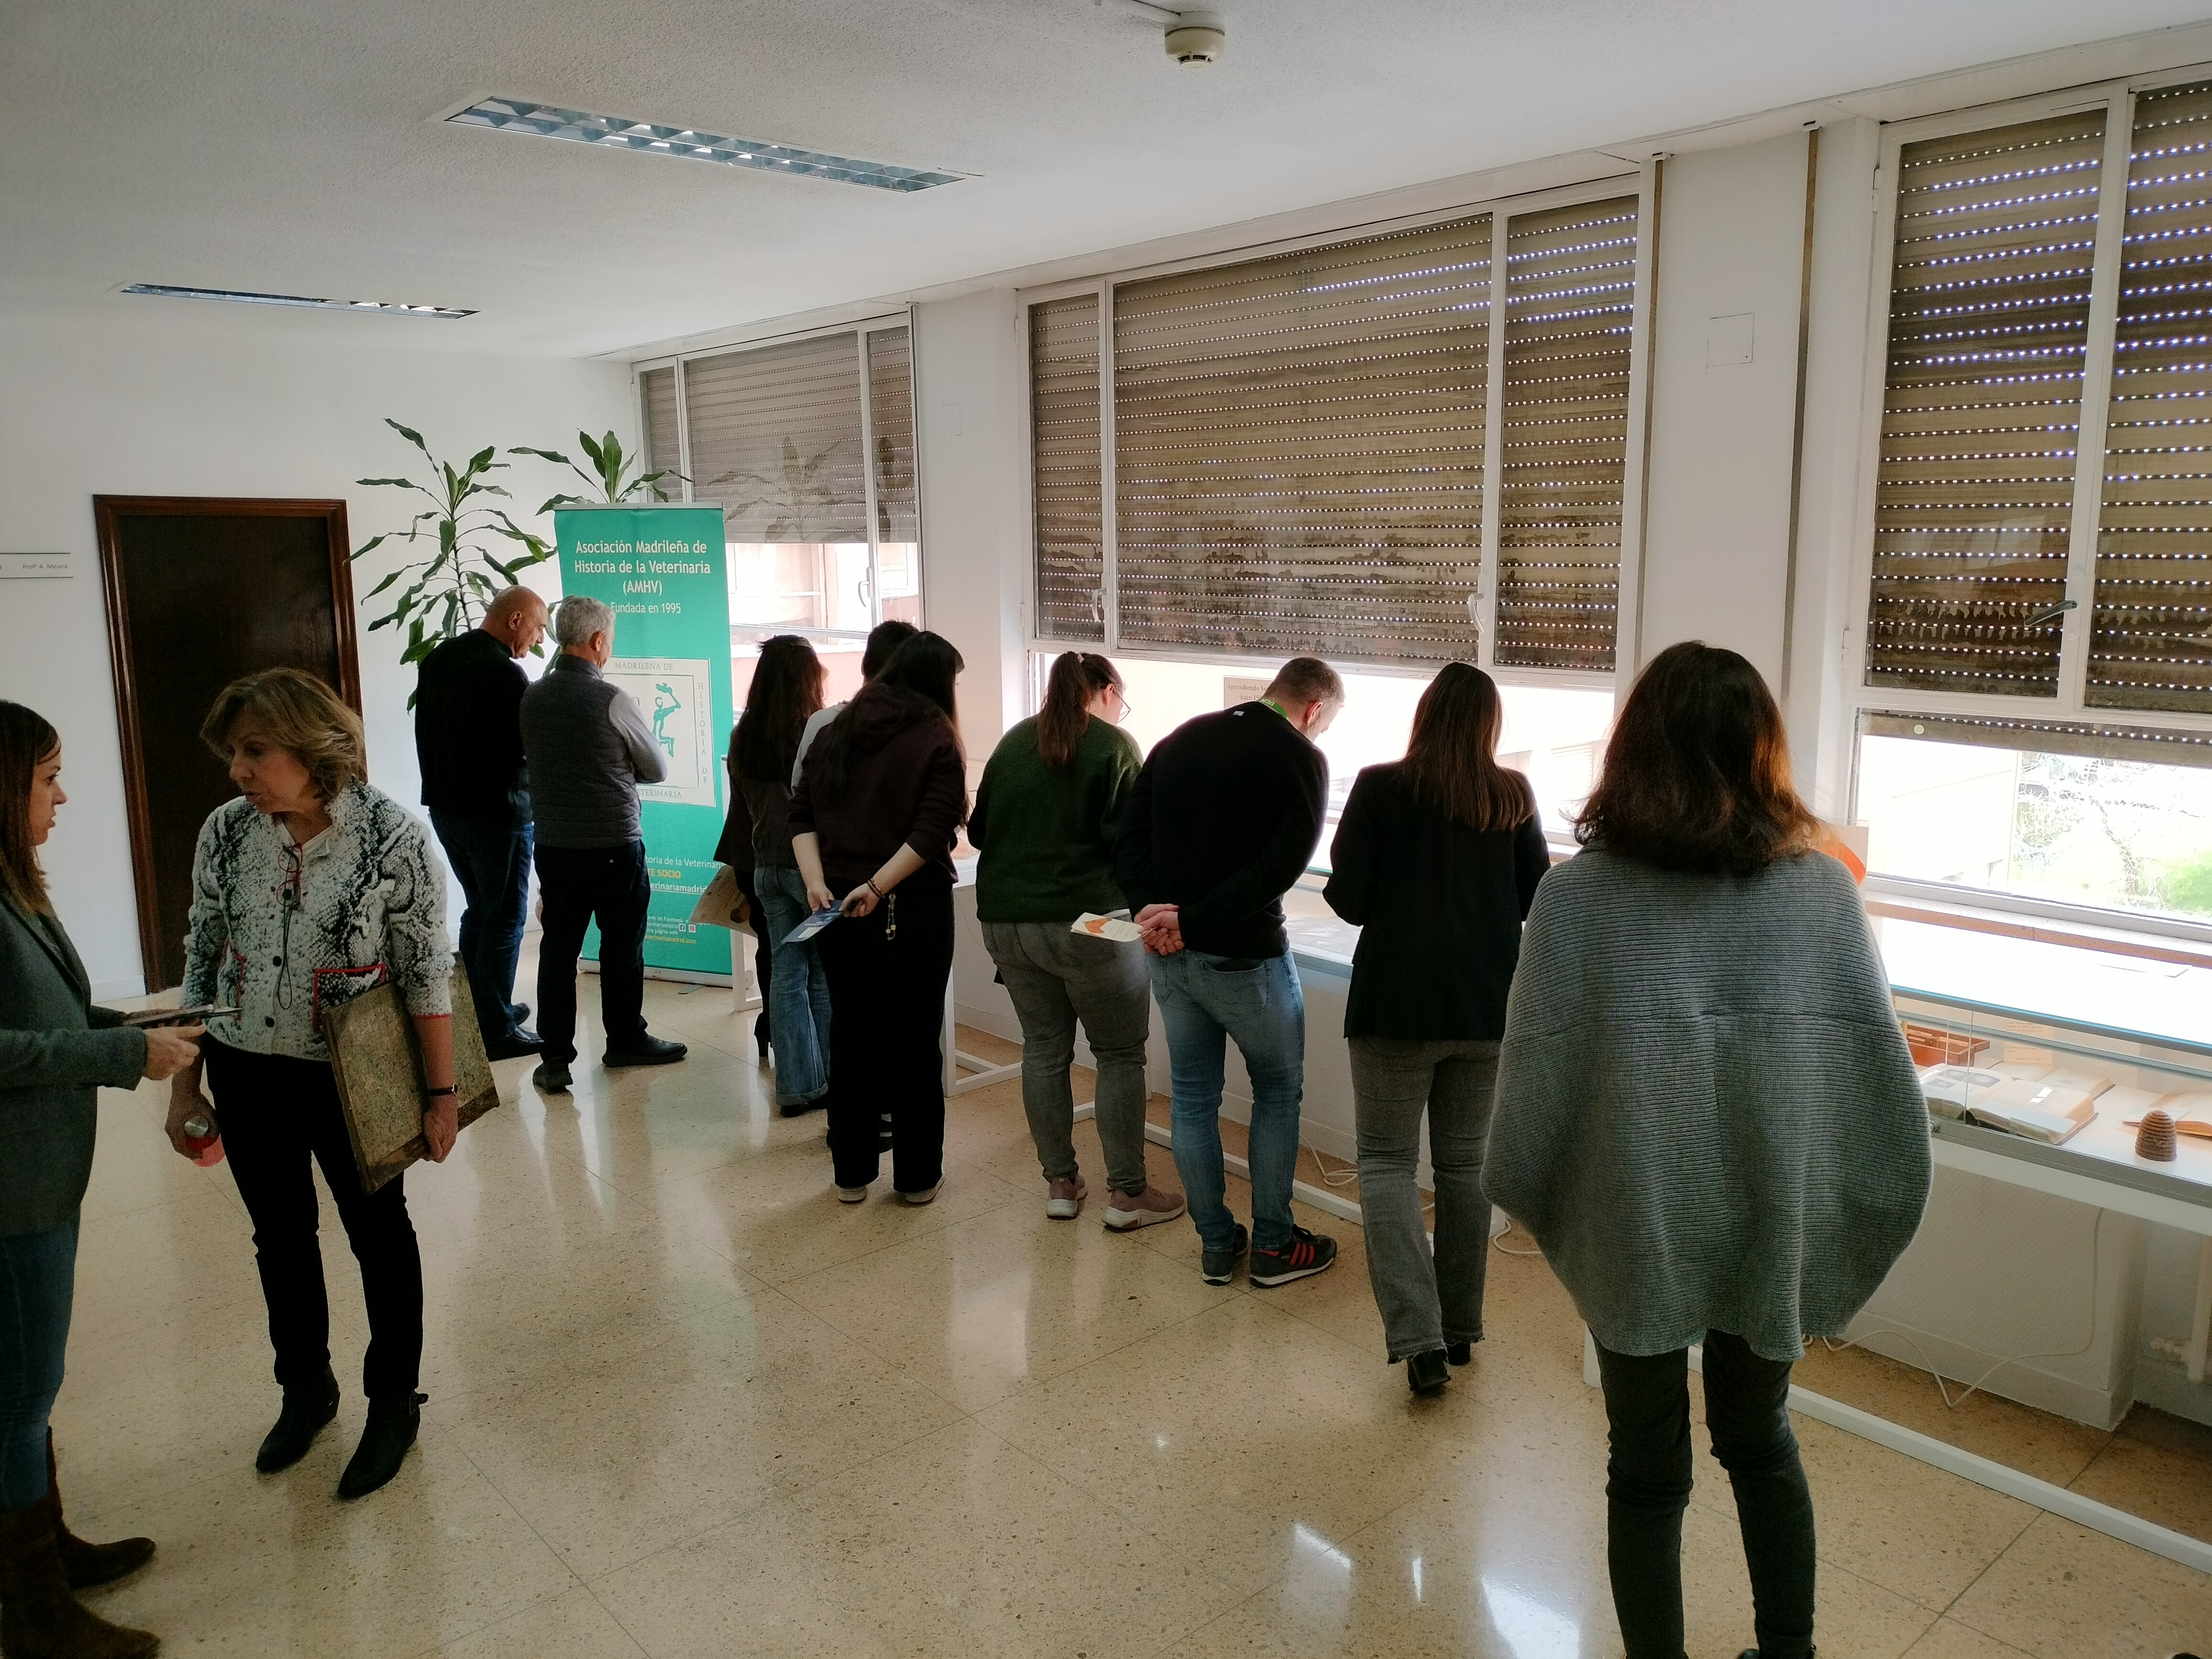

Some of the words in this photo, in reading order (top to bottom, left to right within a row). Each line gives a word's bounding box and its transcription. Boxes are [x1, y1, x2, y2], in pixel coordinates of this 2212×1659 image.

[575, 540, 632, 553] Asociación
[636, 540, 689, 553] Madrileña
[693, 540, 707, 553] de
[575, 560, 616, 573] Historia
[619, 560, 632, 573] de
[636, 560, 646, 573] la
[649, 560, 711, 574] Veterinaria
[623, 580, 663, 596] (AMHV)
[611, 602, 646, 613] Fundada
[648, 605, 659, 613] en
[661, 603, 681, 613] 1995
[615, 662, 661, 670] MADRILEÑA
[1227, 683, 1259, 691] Aprendiendo
[698, 683, 706, 755] HISTORIA
[702, 767, 708, 783] DE
[664, 857, 673, 865] de
[675, 858, 682, 866] la
[657, 869, 682, 879] SOCIO
